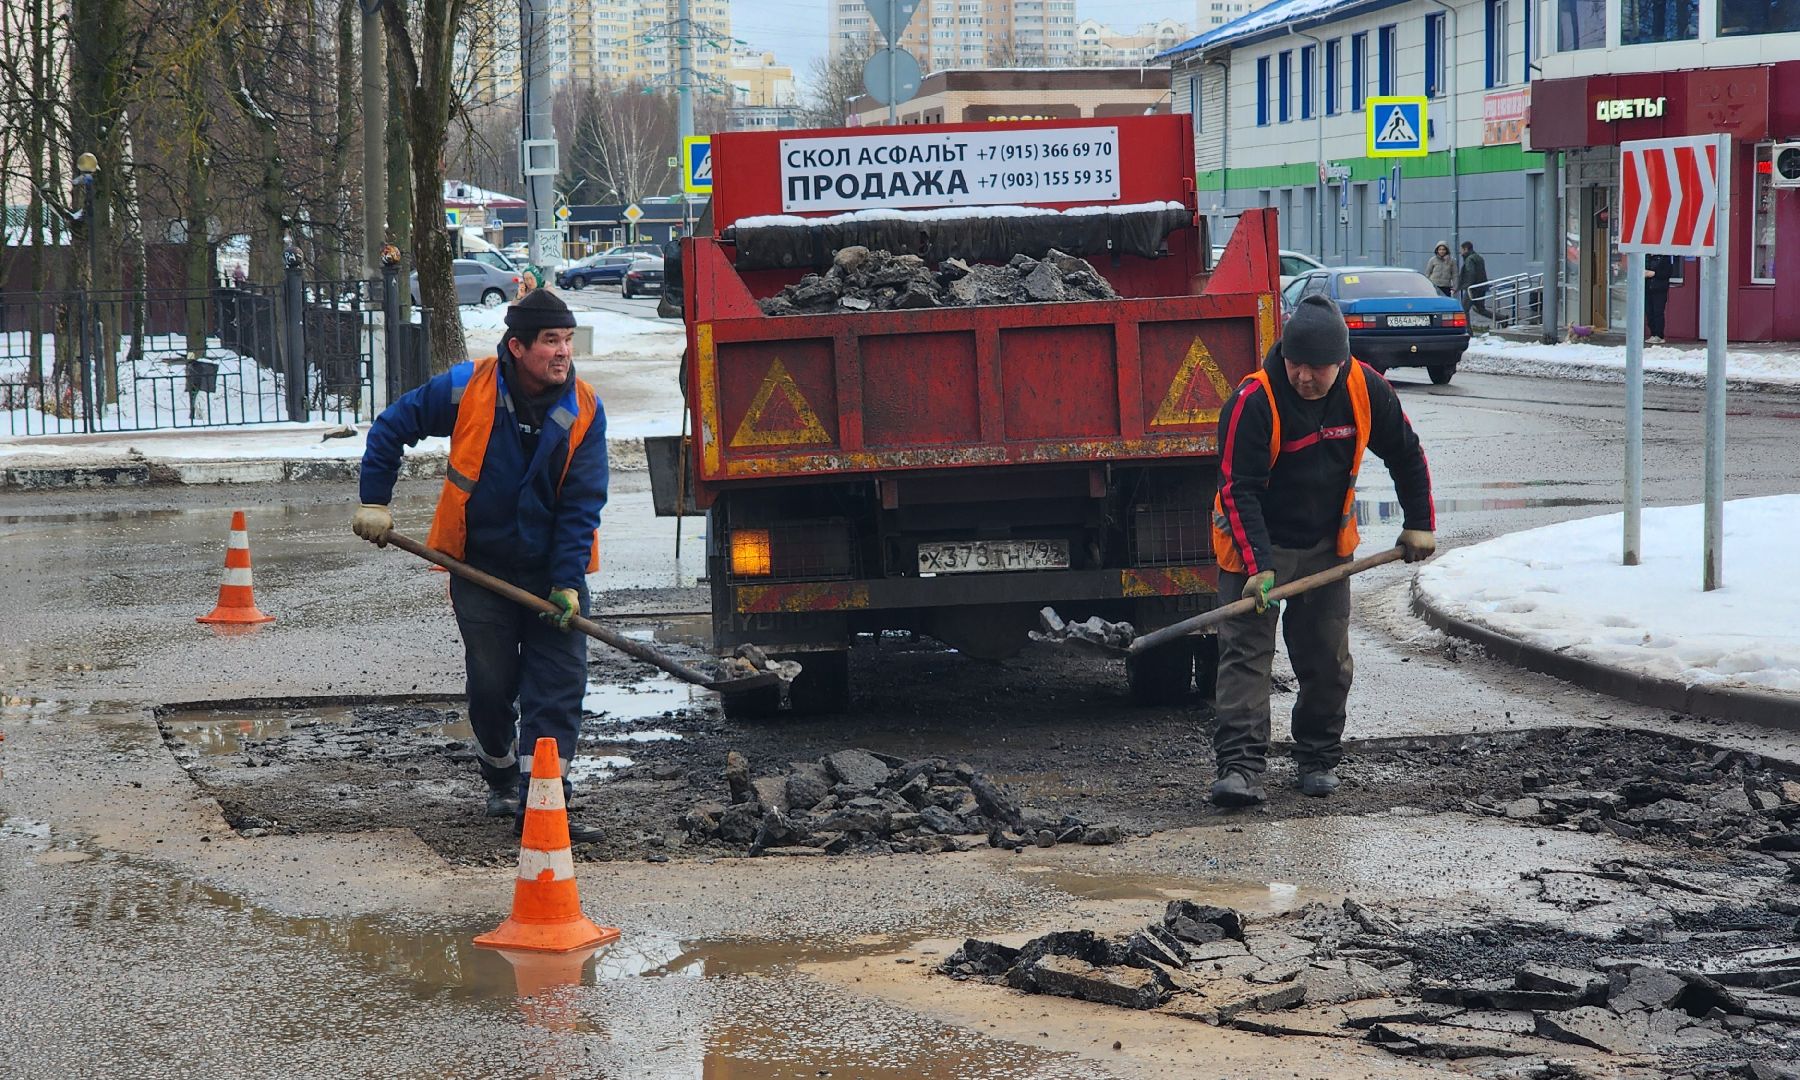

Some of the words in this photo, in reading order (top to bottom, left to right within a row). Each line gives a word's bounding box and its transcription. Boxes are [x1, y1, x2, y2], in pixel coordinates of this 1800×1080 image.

[1596, 96, 1667, 123] ЦВЕТЫ
[787, 148, 850, 169] СКОЛ
[858, 143, 968, 166] АСФАЛЬТ
[976, 145, 997, 161] +7
[1001, 143, 1039, 162] (915)
[1042, 143, 1069, 158] 366
[1072, 142, 1090, 157] 69
[1094, 141, 1112, 157] 70
[787, 169, 969, 202] ПРОДАЖА
[977, 173, 998, 189] +7
[1001, 171, 1040, 190] (903)
[1043, 170, 1070, 186] 155
[1073, 169, 1092, 185] 59
[1095, 169, 1112, 184] 35
